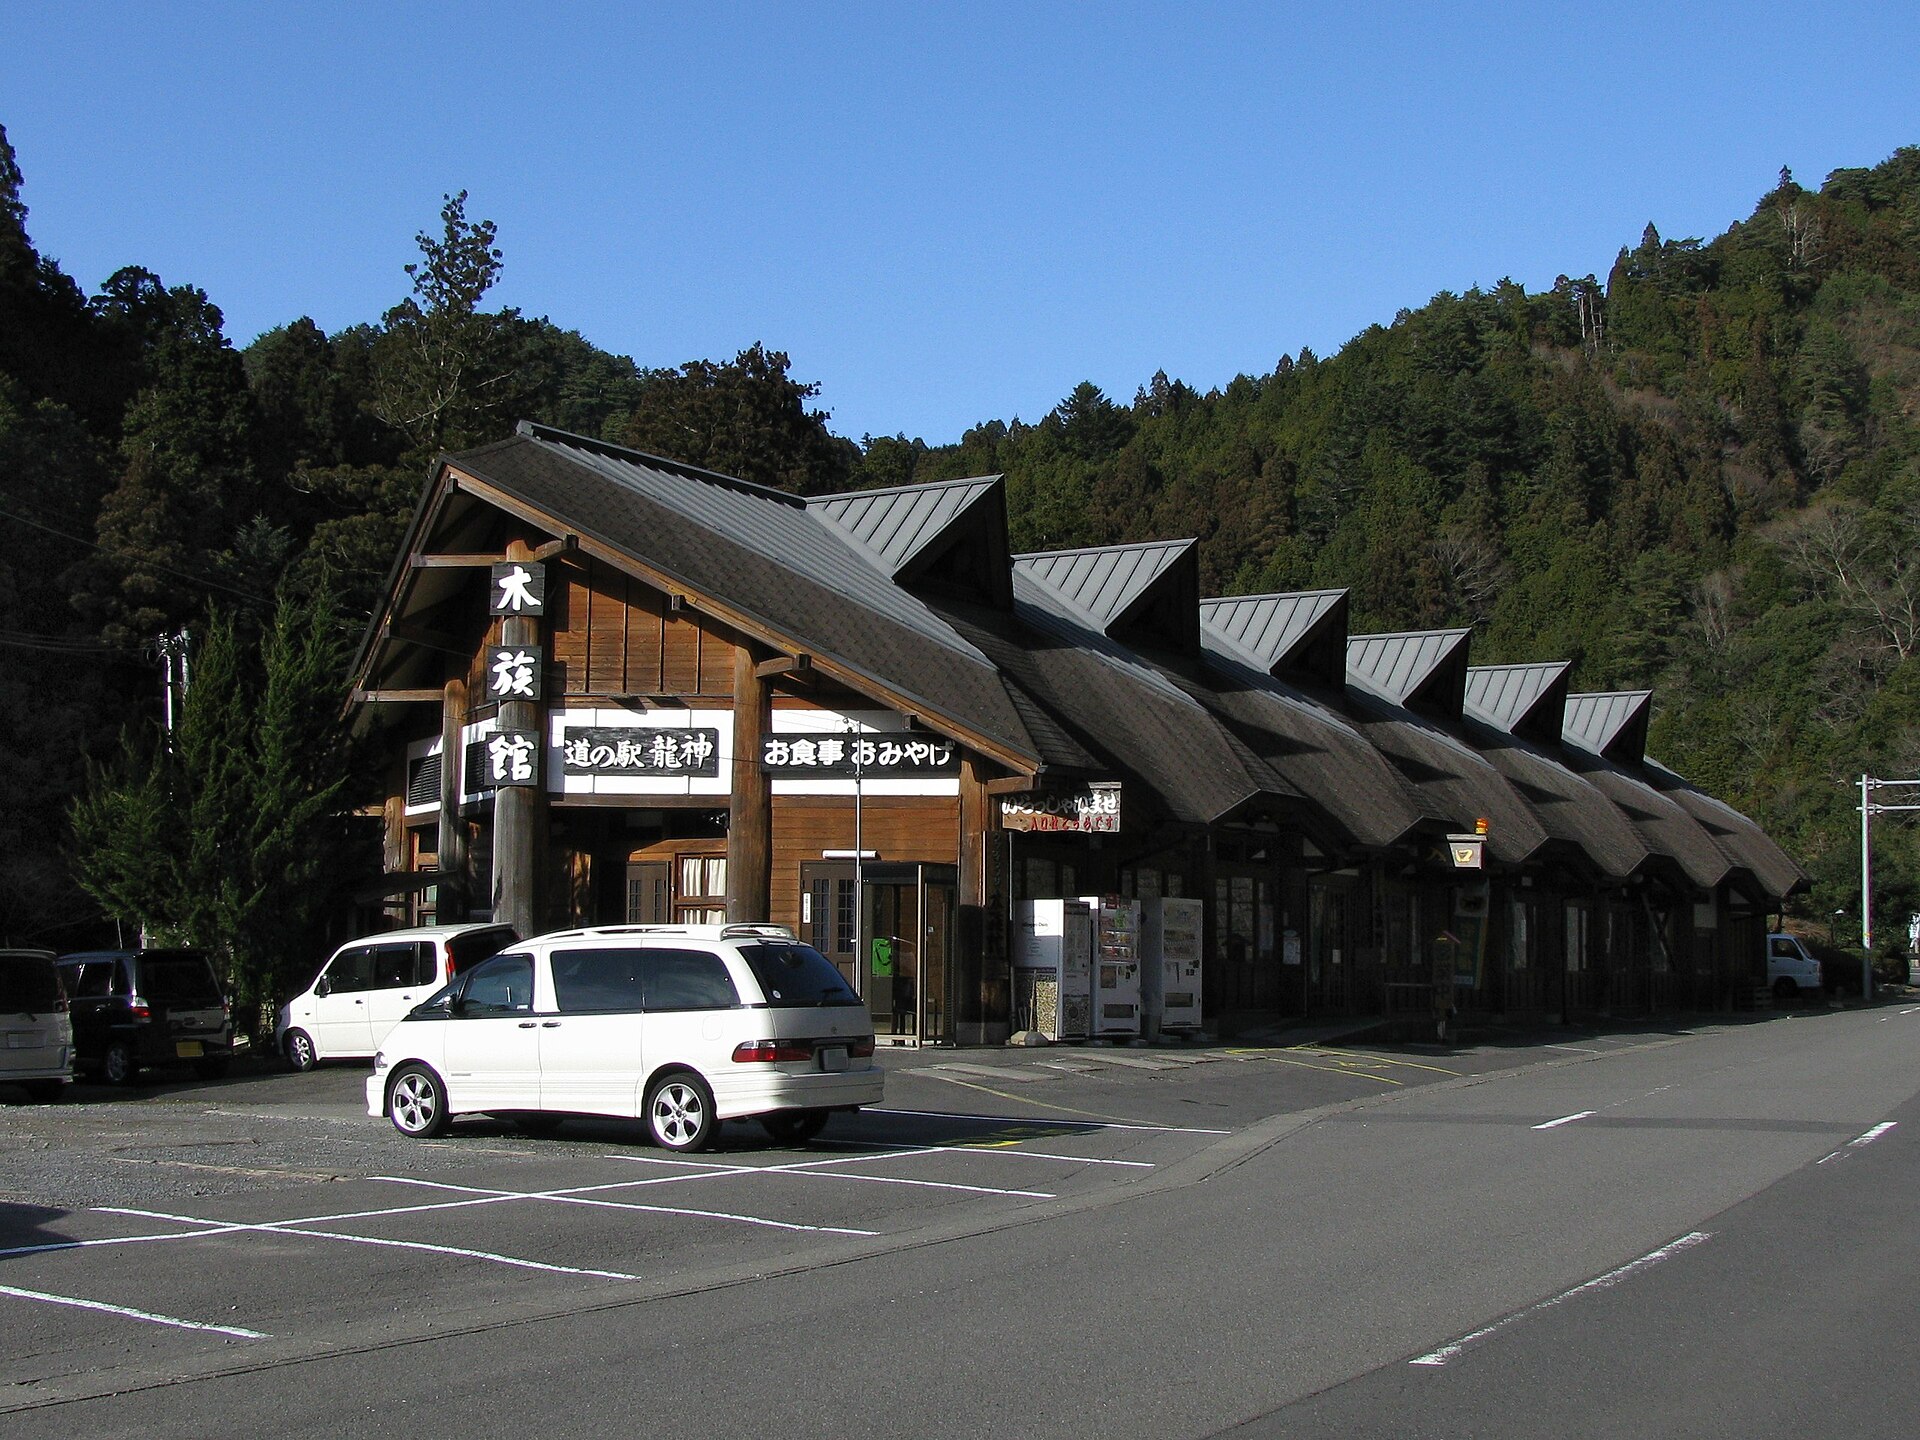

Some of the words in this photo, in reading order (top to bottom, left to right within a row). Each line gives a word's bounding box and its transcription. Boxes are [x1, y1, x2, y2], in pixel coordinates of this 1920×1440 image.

[489, 565, 542, 781] 木族館
[764, 739, 845, 766] お食事
[850, 739, 955, 767] おみやげ
